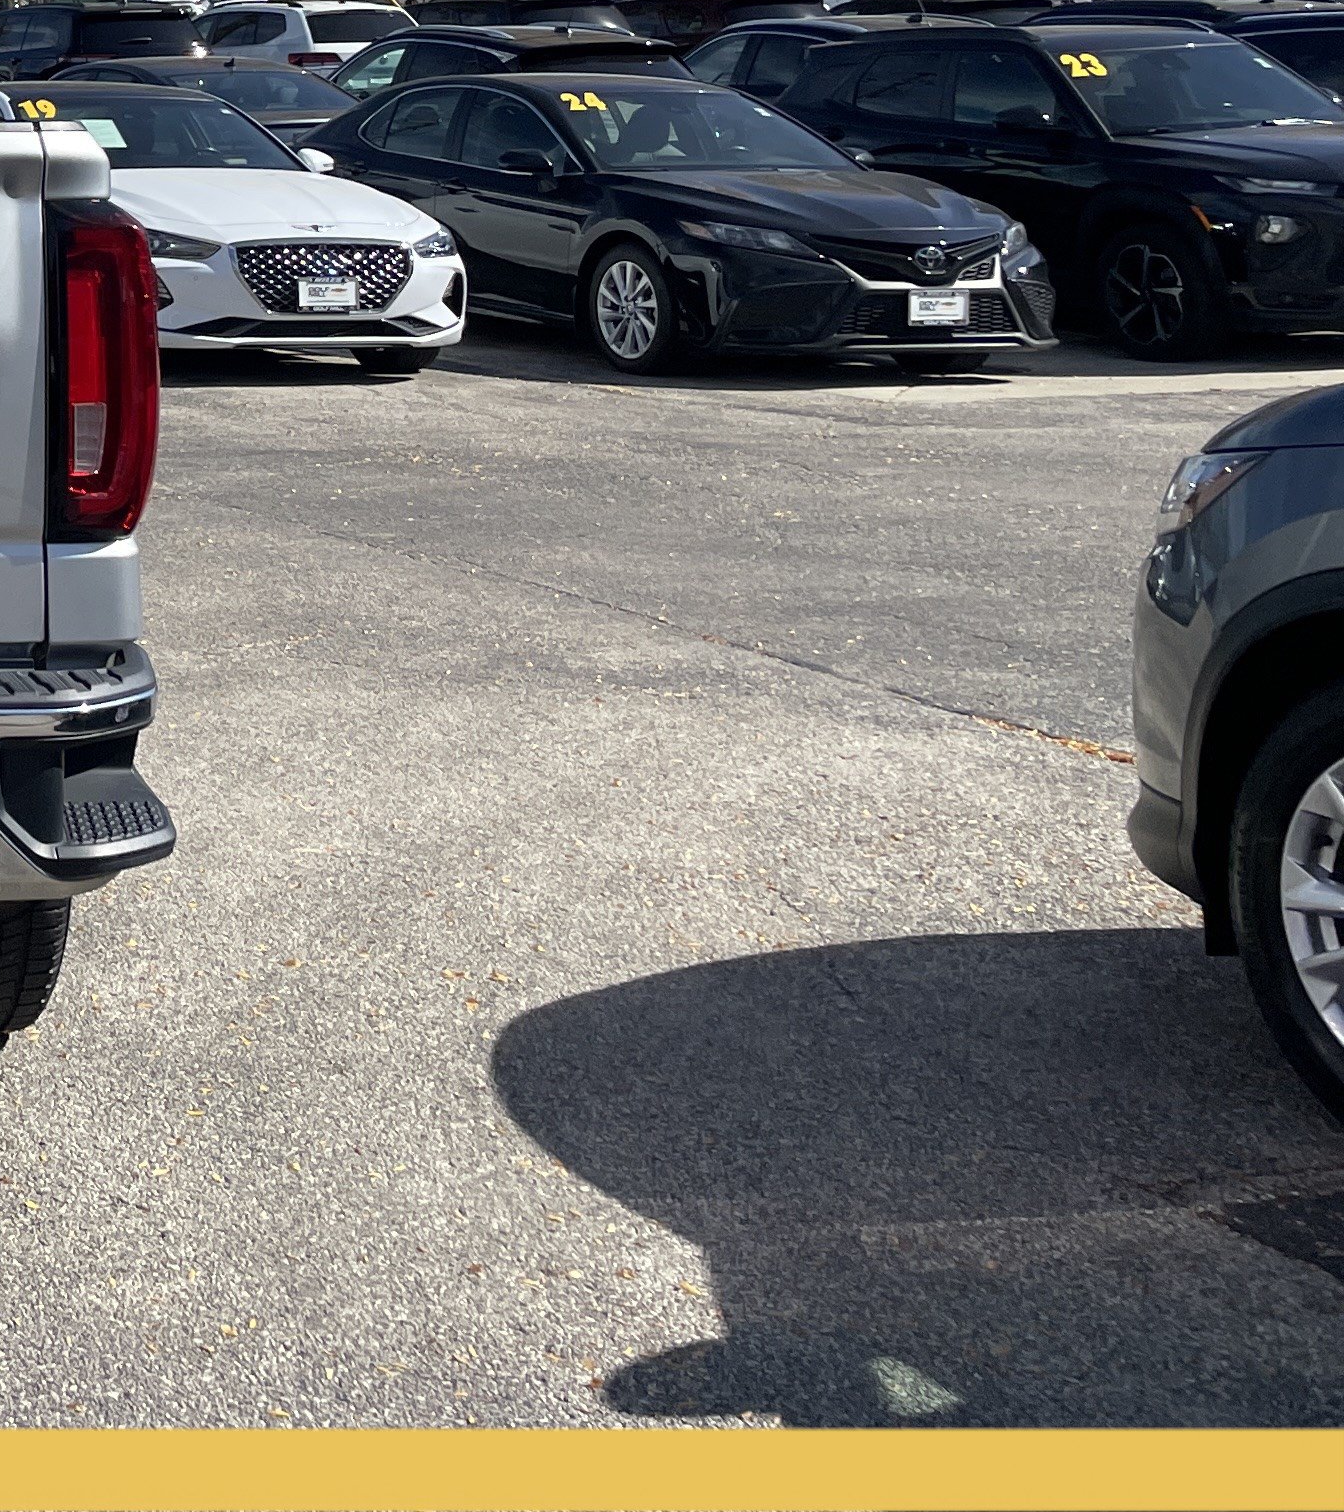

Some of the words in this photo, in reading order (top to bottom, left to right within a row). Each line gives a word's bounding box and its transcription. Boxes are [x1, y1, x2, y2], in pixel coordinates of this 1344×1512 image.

[1059, 53, 1108, 77] 23
[17, 99, 57, 119] 19
[560, 92, 607, 111] 24
